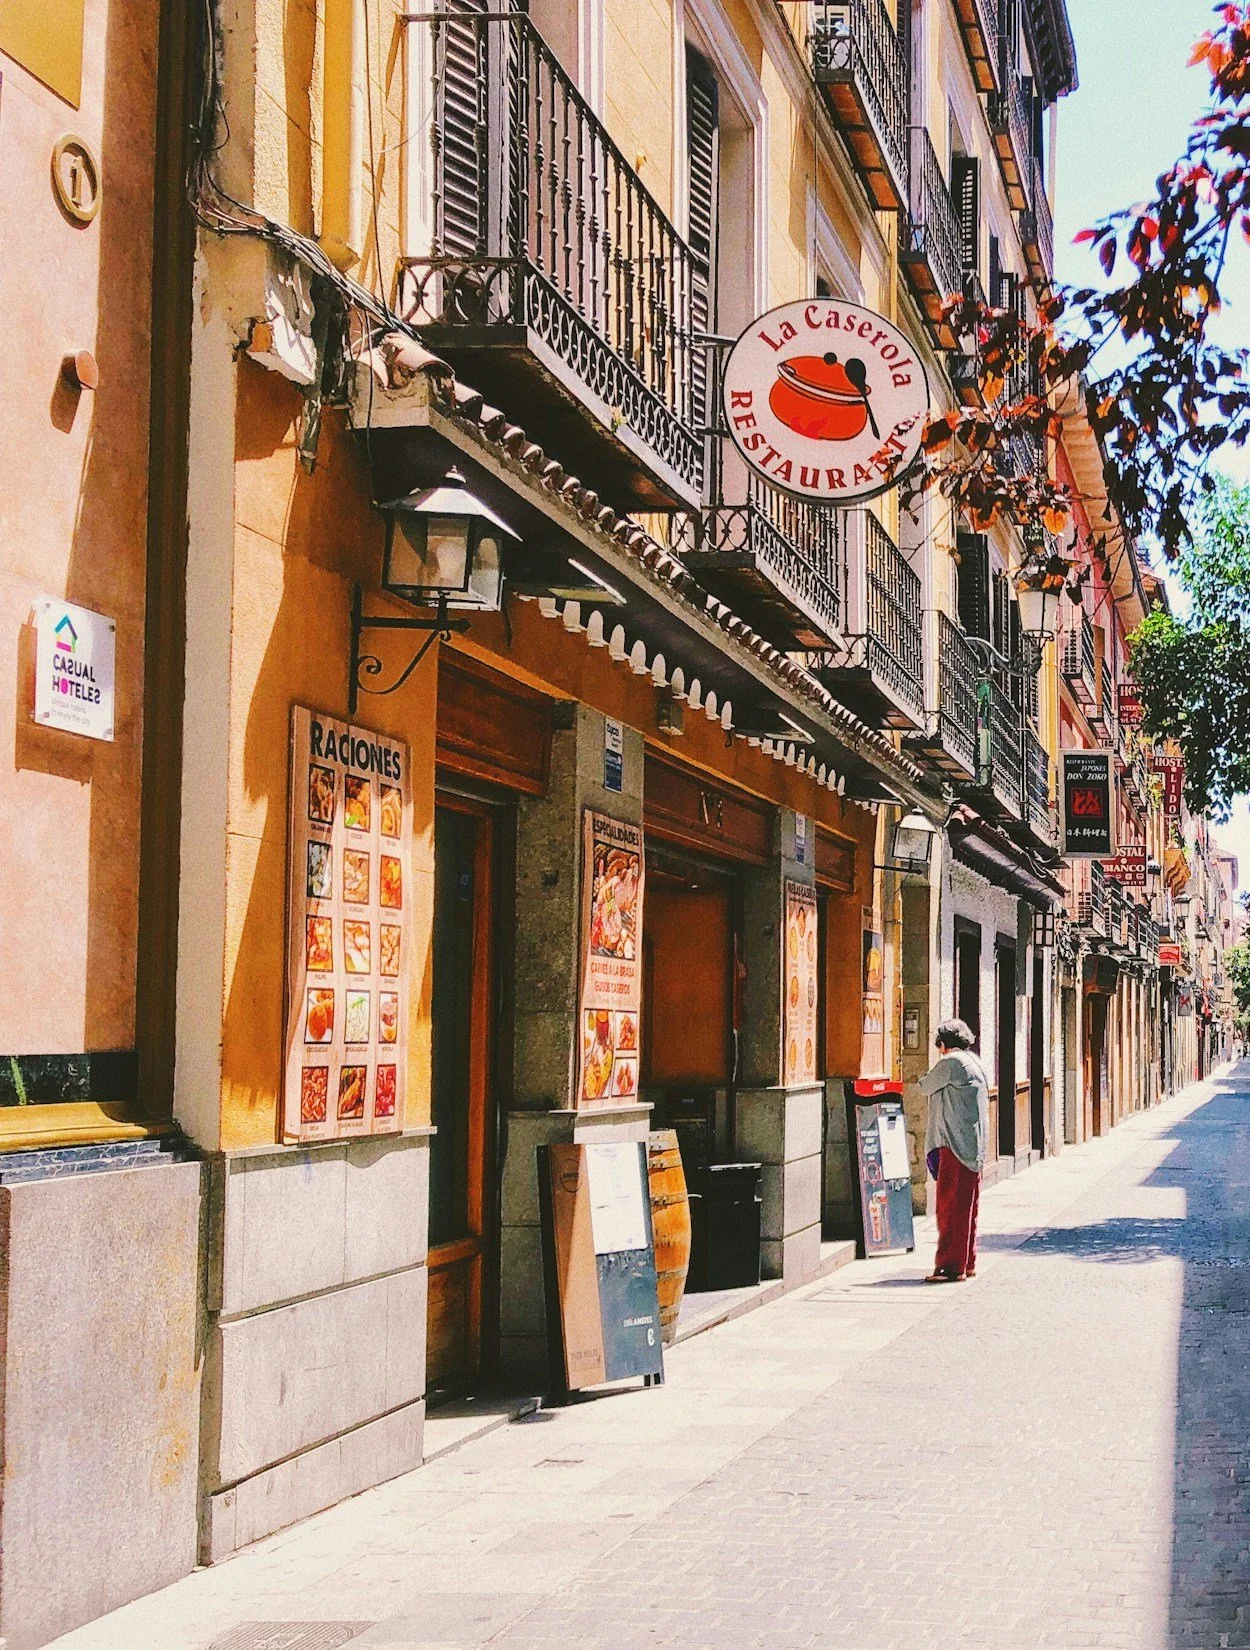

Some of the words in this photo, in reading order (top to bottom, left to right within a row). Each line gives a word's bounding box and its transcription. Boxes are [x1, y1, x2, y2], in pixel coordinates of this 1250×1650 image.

[758, 320, 798, 352] La
[804, 305, 913, 389] Caserola
[731, 390, 916, 491] RESTAURANT
[53, 653, 96, 683] CASUAL
[52, 674, 100, 705] HOTELES
[310, 721, 401, 781] RACIONES
[1168, 773, 1178, 814] LIDO
[1103, 864, 1146, 872] BIANCO
